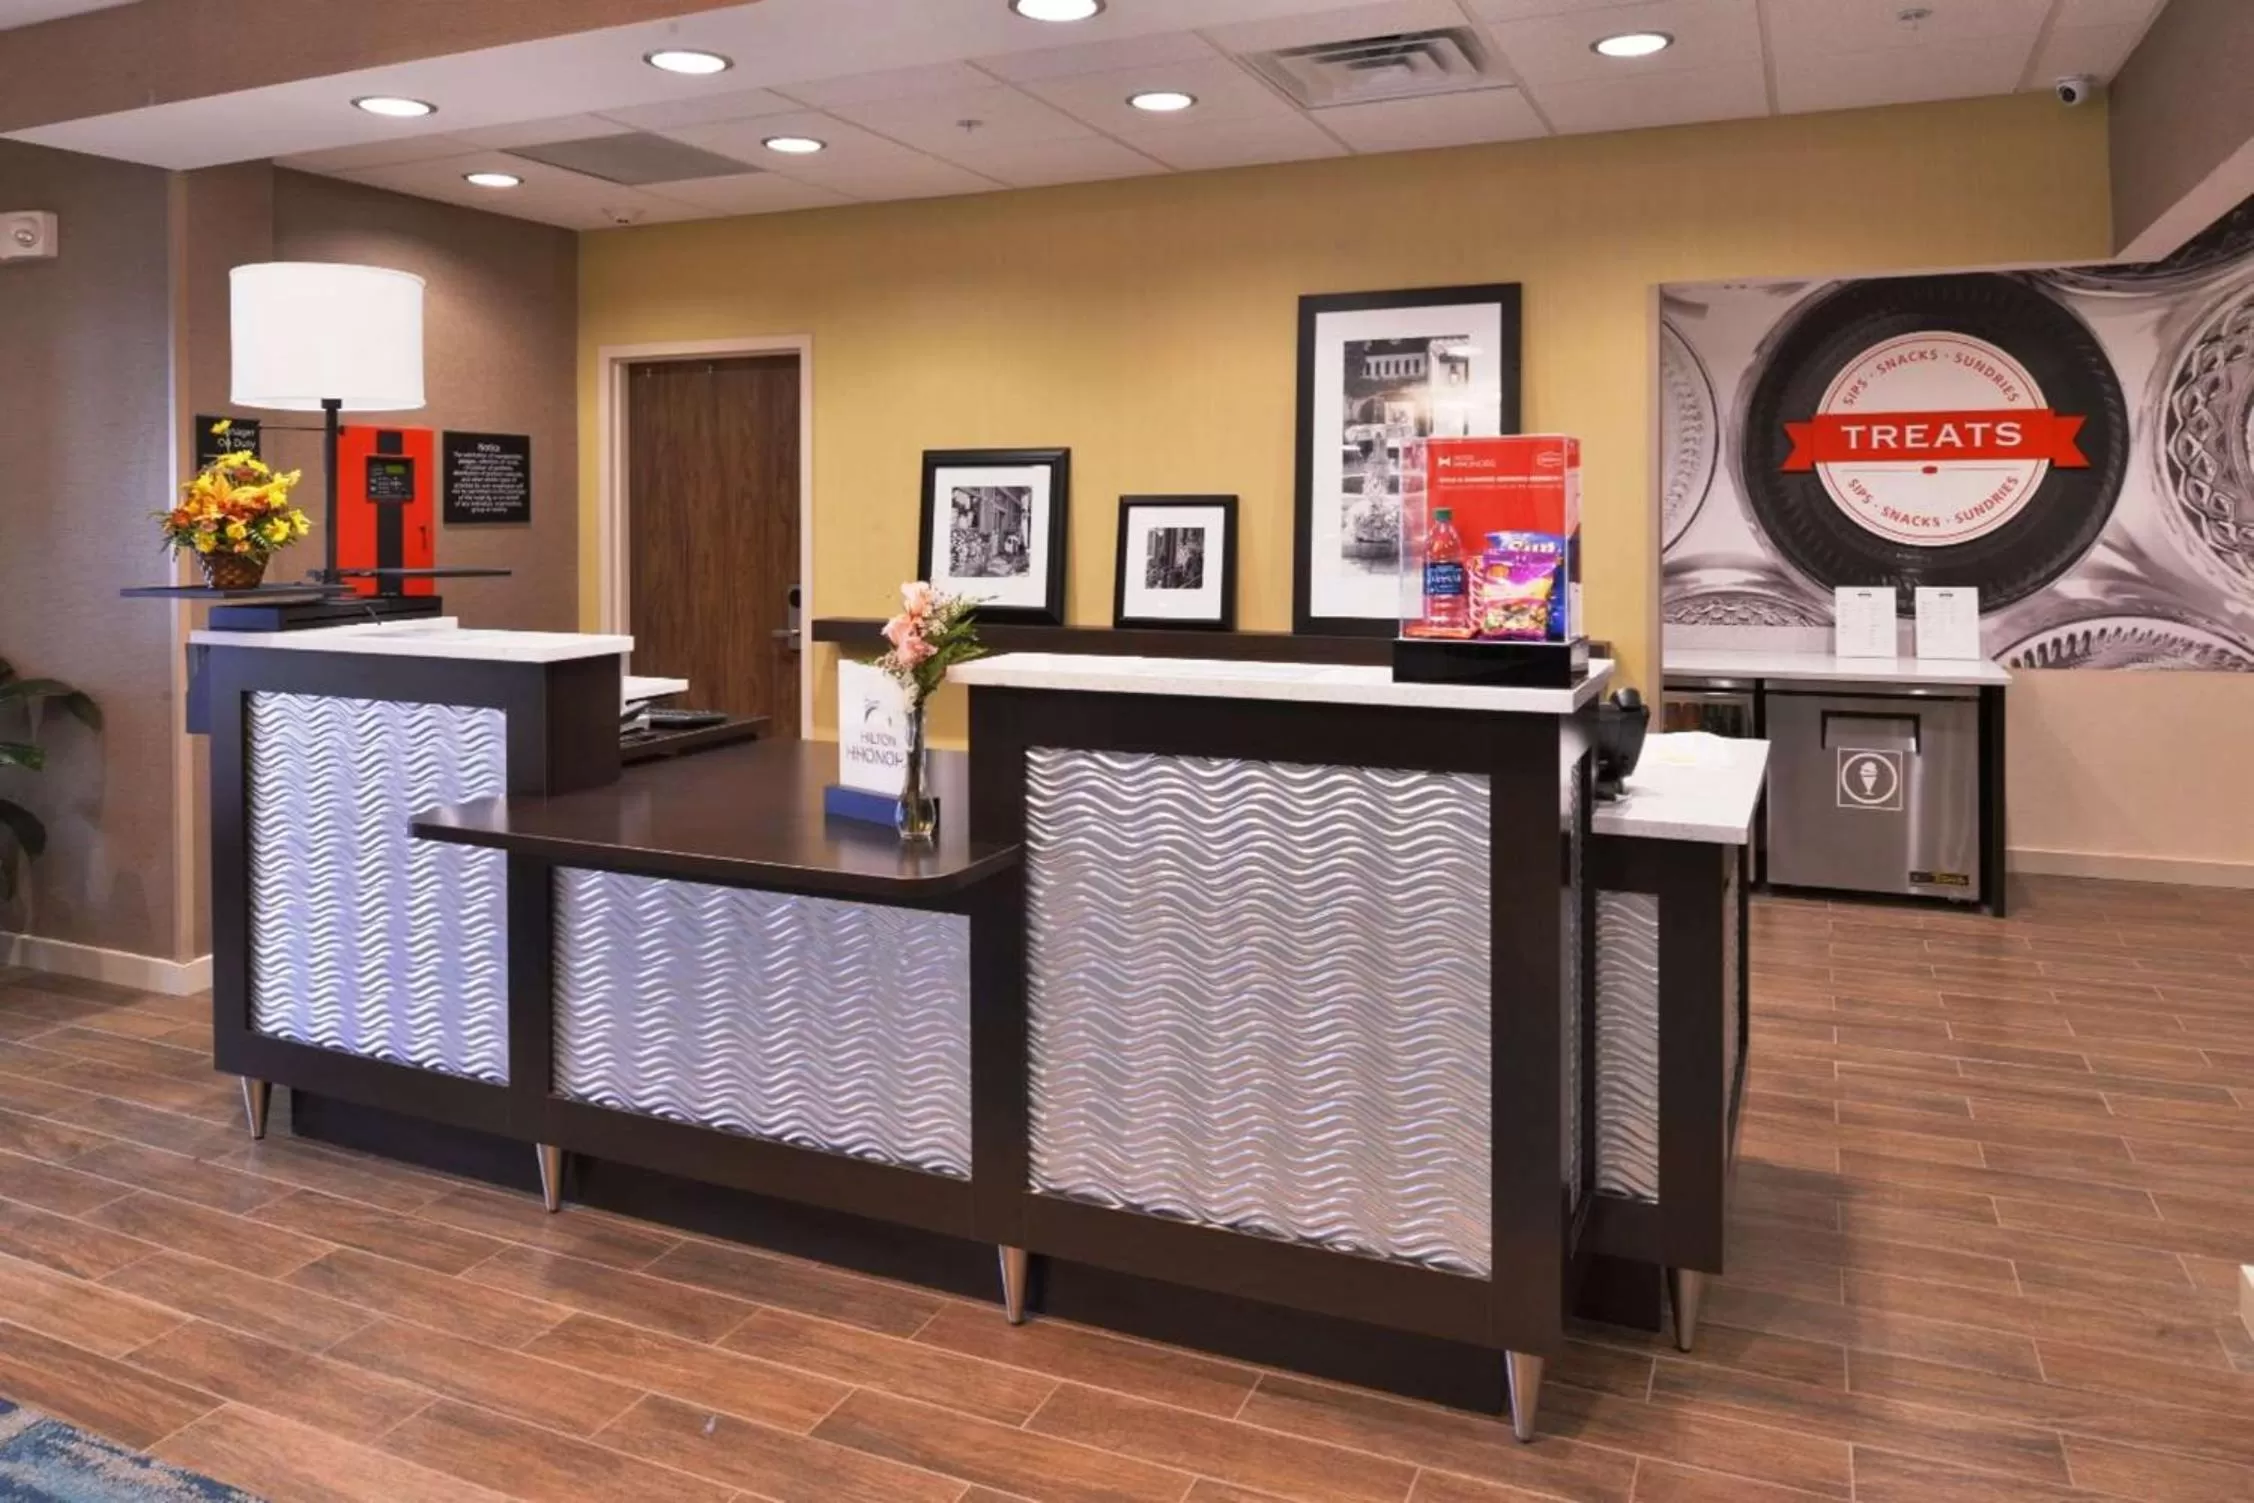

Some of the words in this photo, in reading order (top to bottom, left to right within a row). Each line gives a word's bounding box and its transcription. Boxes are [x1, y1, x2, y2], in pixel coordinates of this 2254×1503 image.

[1843, 377, 1868, 405] SIPS
[1876, 348, 1938, 374] SNACKS
[1953, 352, 2019, 402] SUNDRIES
[1840, 421, 2023, 450] TREATS
[1848, 478, 1874, 504] SIPS
[1880, 506, 1941, 528] SNACKS
[1955, 476, 2019, 524] SUNDRIES
[860, 731, 897, 747] HILTON
